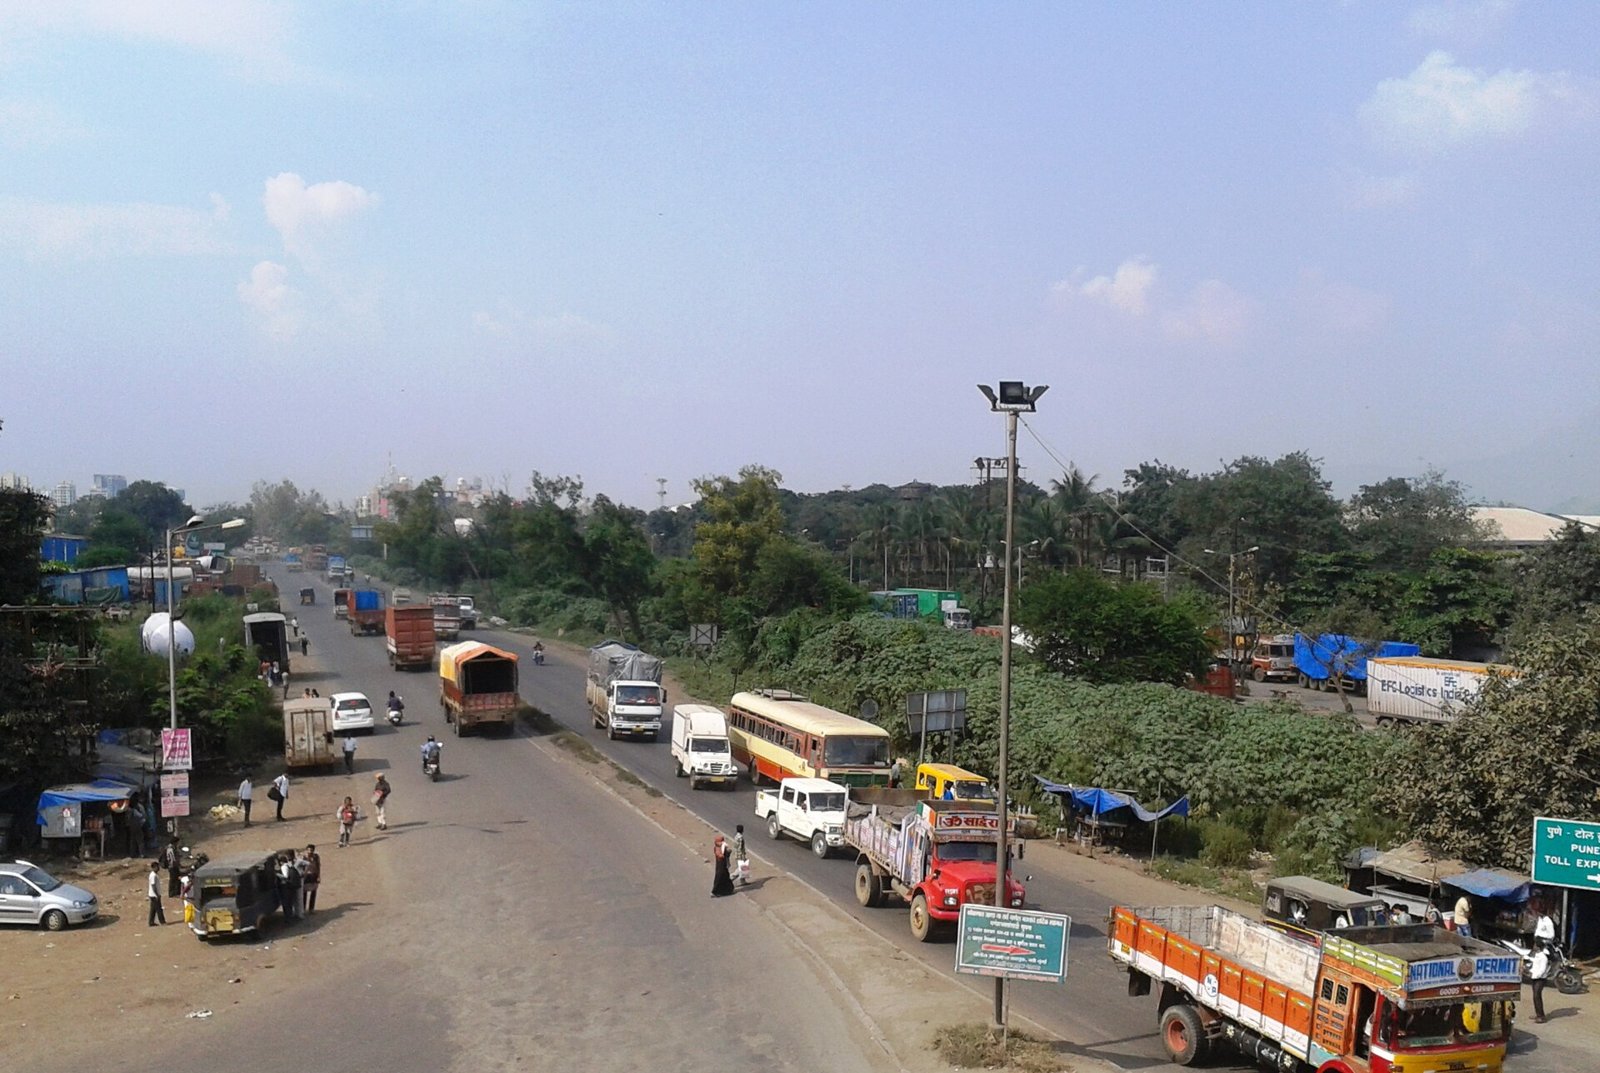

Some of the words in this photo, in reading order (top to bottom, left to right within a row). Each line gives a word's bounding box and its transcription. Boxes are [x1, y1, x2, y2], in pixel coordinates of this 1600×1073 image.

[1547, 825, 1563, 839] पुणे
[1574, 828, 1594, 840] टोल
[1571, 844, 1600, 854] PUNE
[1544, 856, 1570, 866] TOLL
[1410, 961, 1456, 980] NATIONAL
[1476, 958, 1518, 973] PERMIT
[1440, 987, 1459, 995] GOODS
